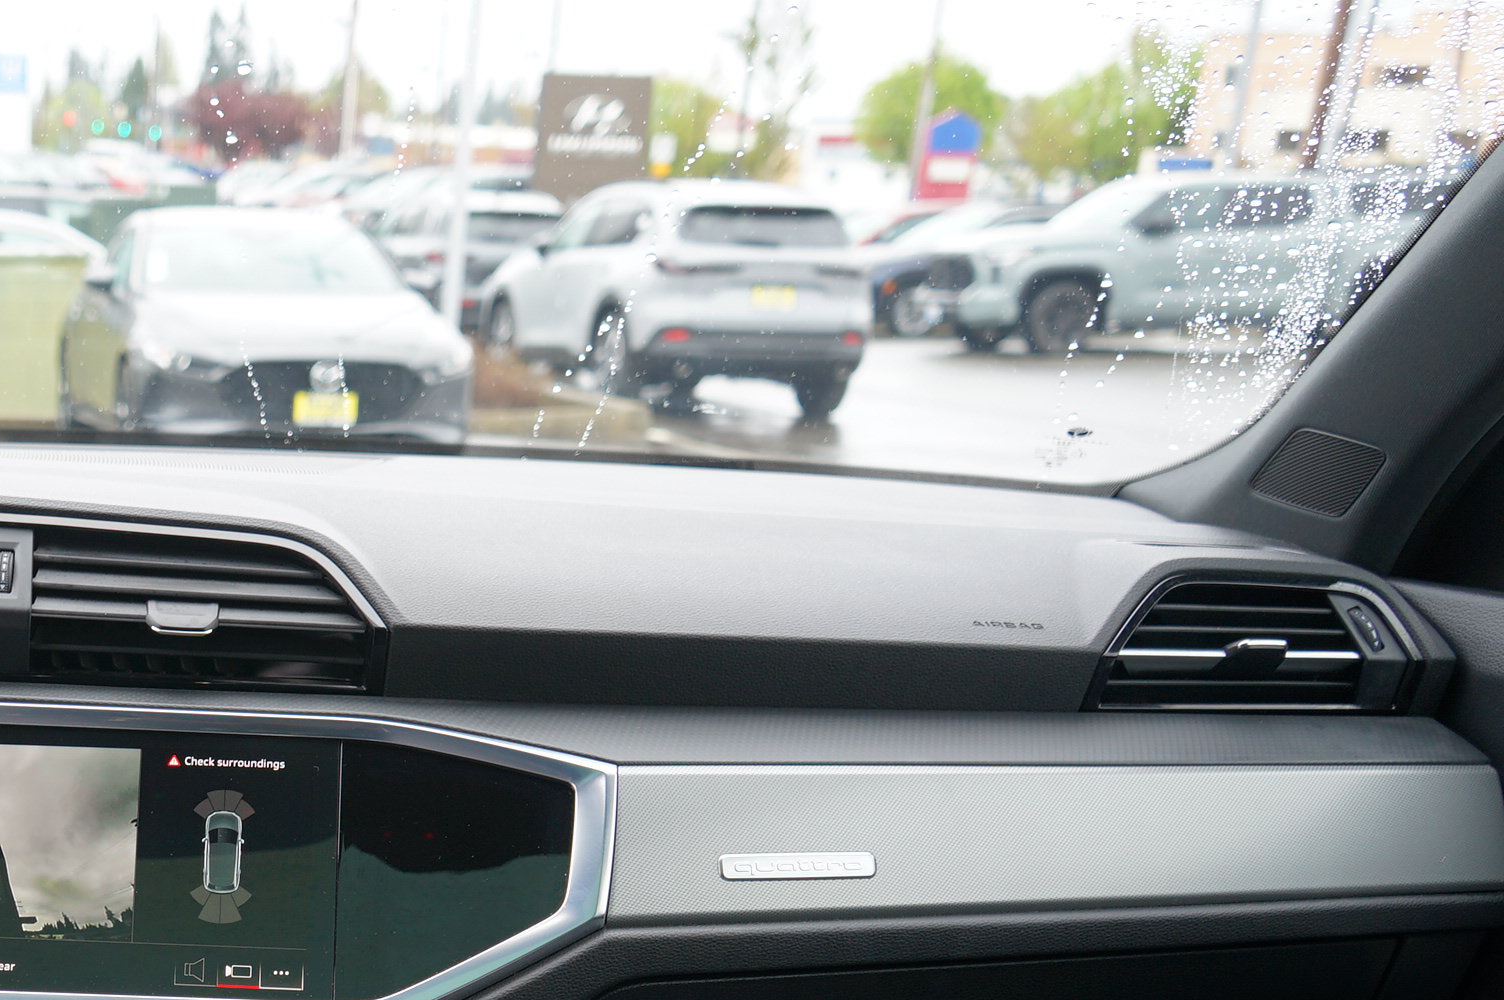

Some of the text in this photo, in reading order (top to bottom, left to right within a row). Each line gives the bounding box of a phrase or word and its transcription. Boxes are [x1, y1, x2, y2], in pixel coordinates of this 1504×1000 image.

[972, 620, 1044, 630] AIRBAG
[184, 756, 286, 771] Check surroundings
[734, 860, 864, 877] quattro
